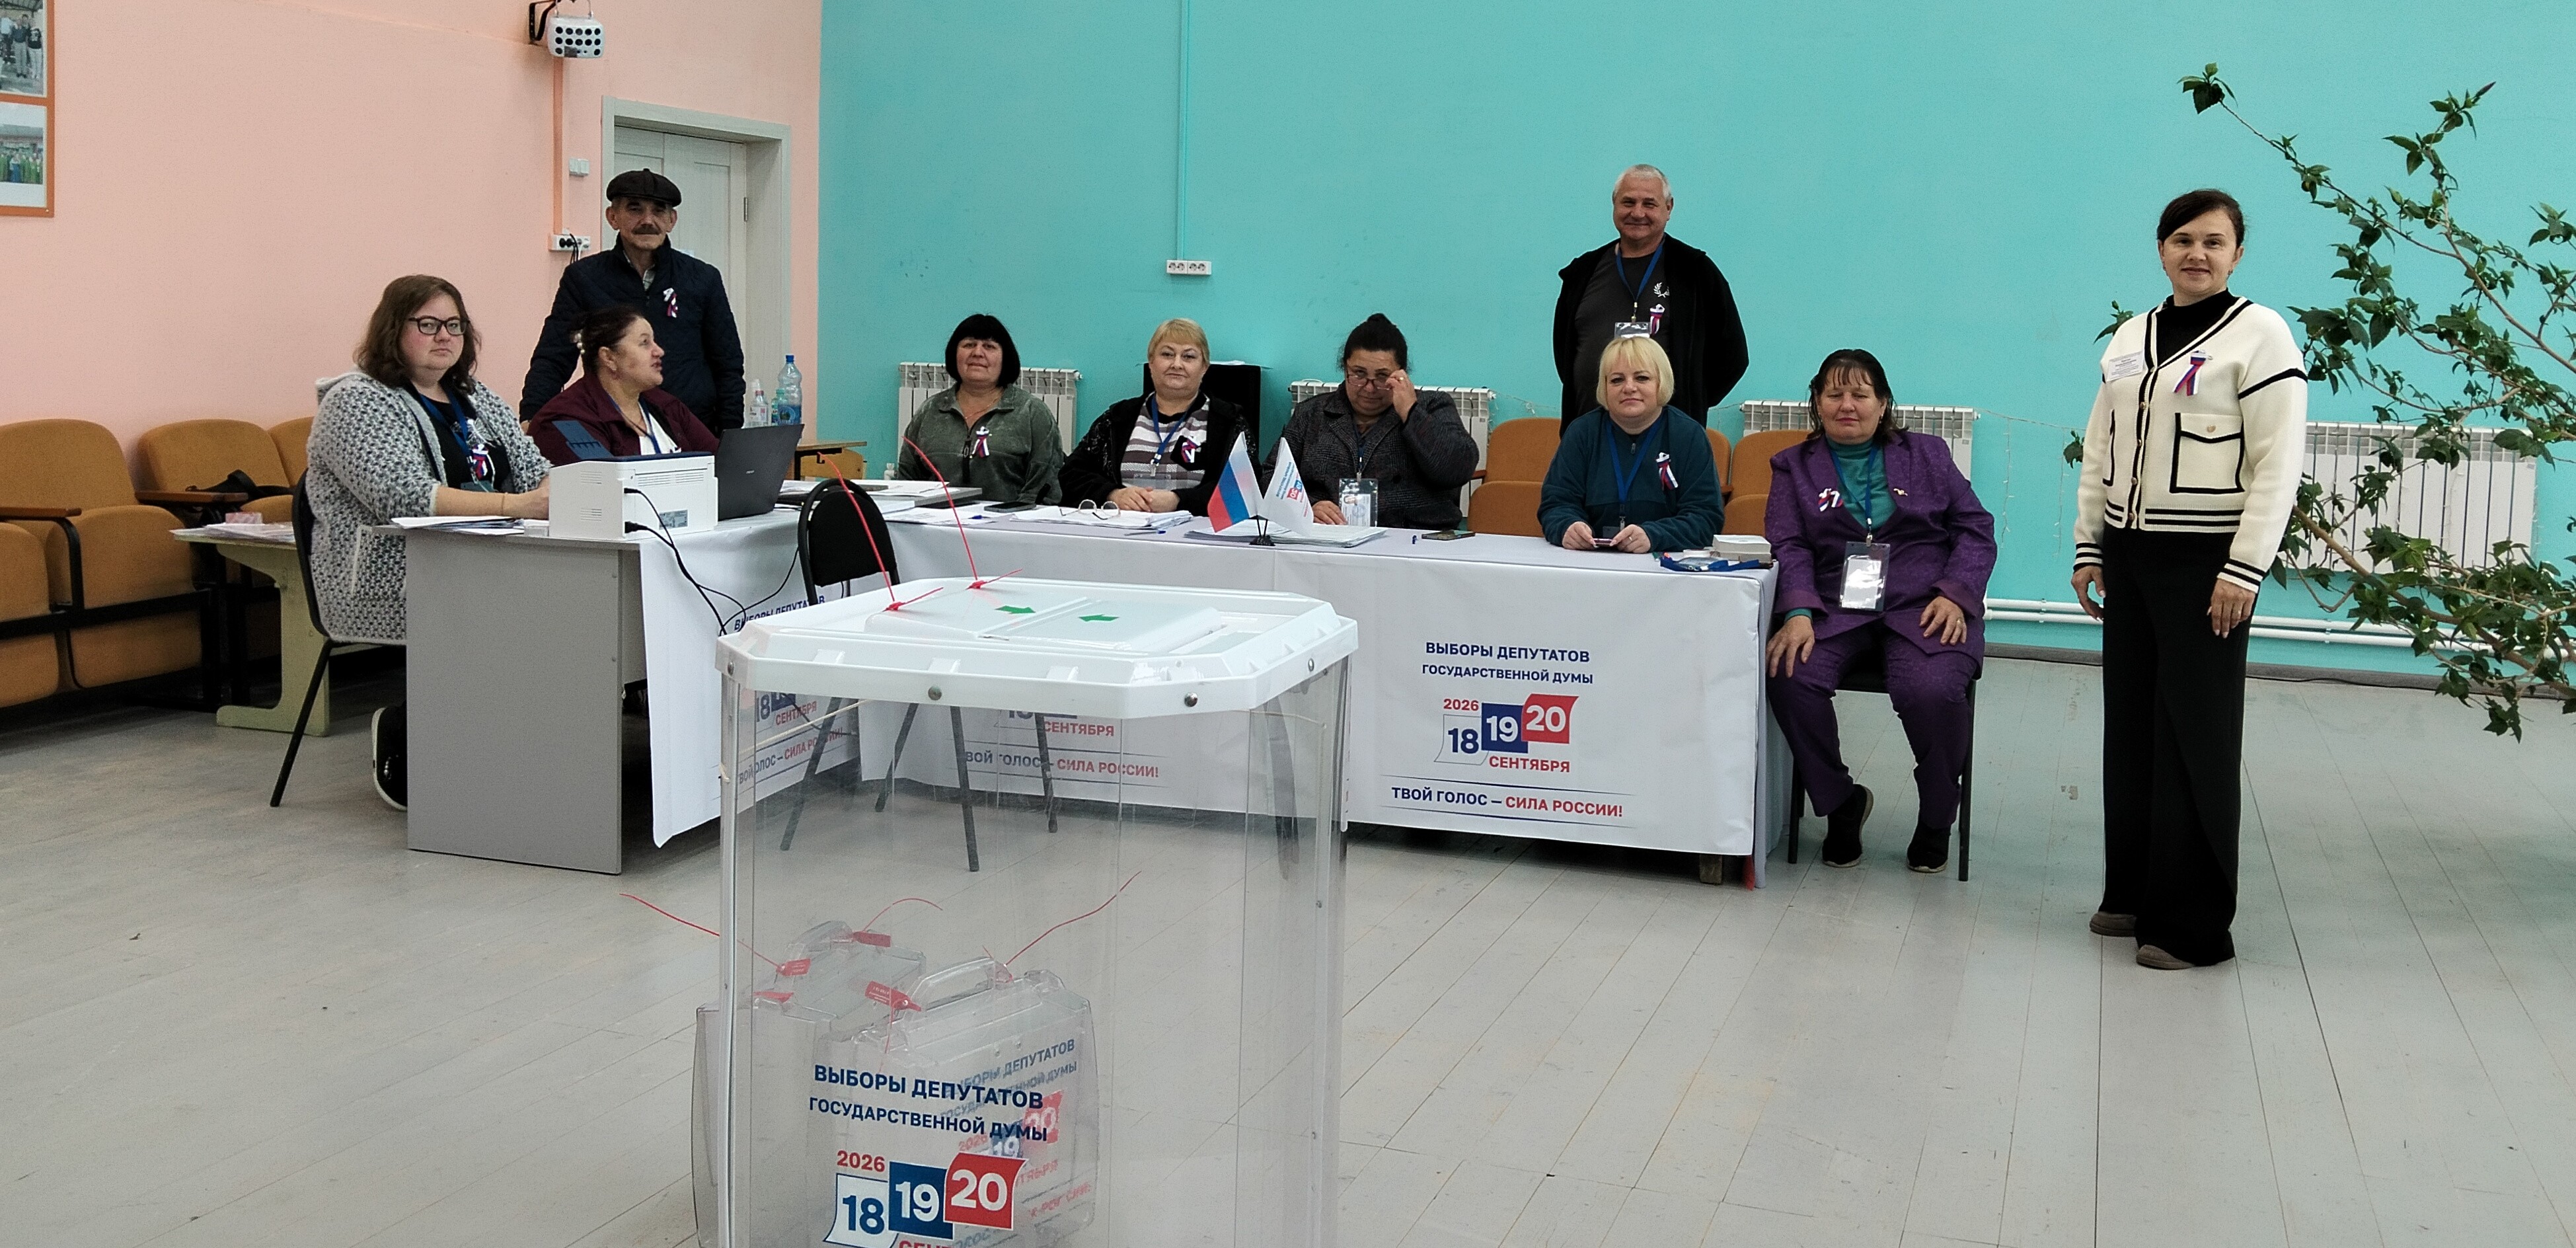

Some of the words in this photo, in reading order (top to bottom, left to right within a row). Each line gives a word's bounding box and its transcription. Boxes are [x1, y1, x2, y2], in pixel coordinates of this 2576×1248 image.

[1425, 641, 1494, 658] ВЫБОРЫ
[1497, 645, 1590, 663] ДЕПУТАТОВ
[1422, 664, 1550, 682] ГОСУДАРСТВЕННОЙ
[1552, 671, 1593, 684] ДУМЫ
[1443, 697, 1480, 712] 2026
[1043, 721, 1115, 737] СЕНТЯБРЯ
[1447, 727, 1480, 754] 18
[1486, 715, 1519, 742] 19
[1526, 704, 1566, 733] 20
[784, 744, 806, 760] СИЛА
[1057, 758, 1094, 773] СИЛА
[1098, 762, 1159, 778] РОССИИ!
[1489, 756, 1570, 773] СЕНТЯБРЯ
[1392, 786, 1434, 802] ТВОЙ
[1437, 791, 1488, 806] ГОЛОС
[1505, 795, 1548, 812] СИЛА
[1552, 800, 1622, 818] РОССИИ!
[1003, 1038, 1075, 1079] ДЕПУТАТОВ
[814, 1064, 907, 1095] ВЫБОРЫ
[911, 1079, 1043, 1110] ДЕПУТАТОВ
[810, 1097, 985, 1136] ГОСУДАРСТВЕННОЙ
[989, 1117, 1048, 1142] ДУМЫ
[837, 1150, 886, 1173] 2026
[842, 1194, 886, 1235] 18
[895, 1181, 940, 1222] 19
[950, 1169, 1008, 1212] 20
